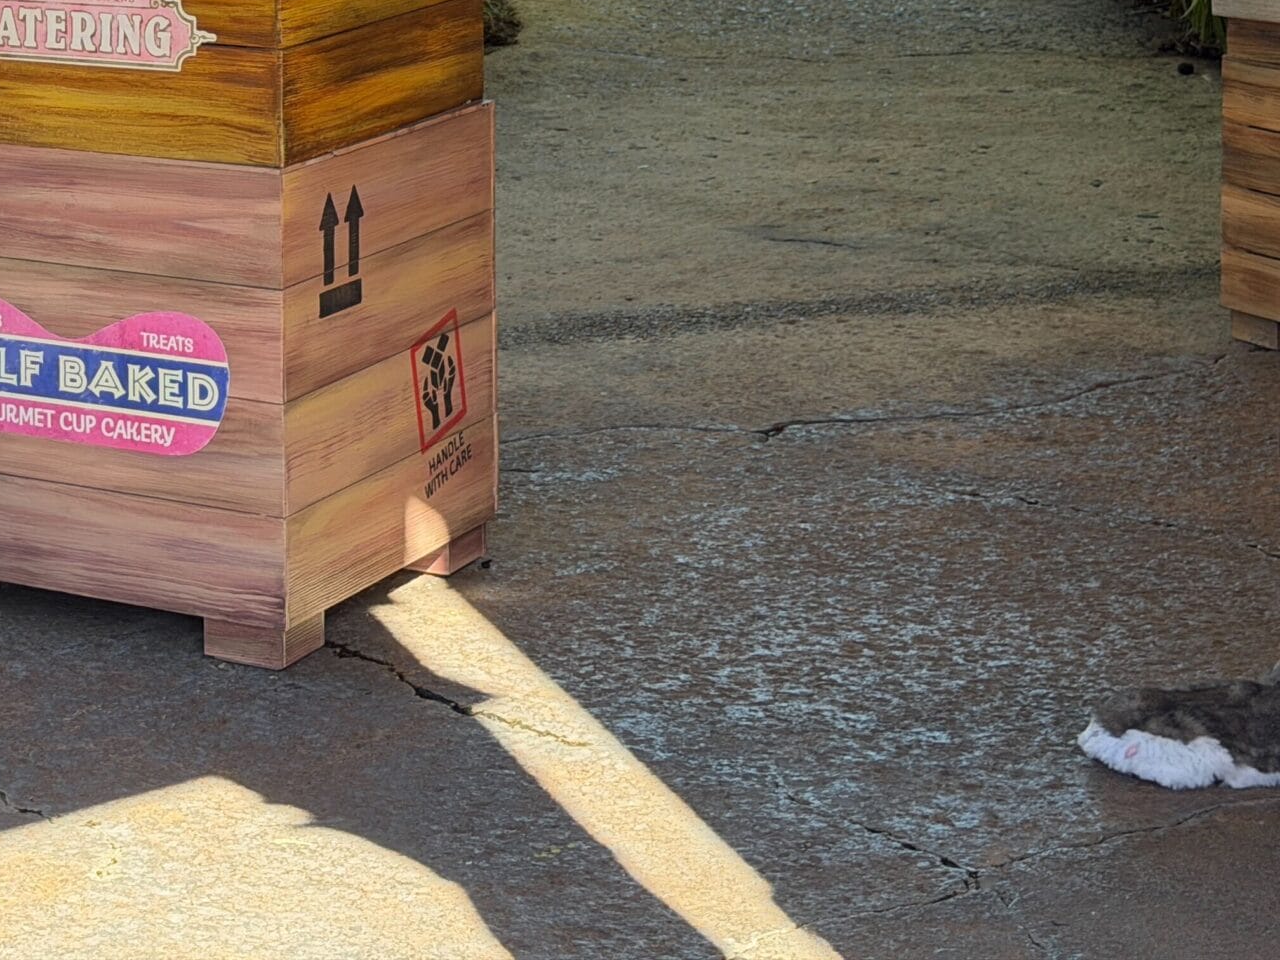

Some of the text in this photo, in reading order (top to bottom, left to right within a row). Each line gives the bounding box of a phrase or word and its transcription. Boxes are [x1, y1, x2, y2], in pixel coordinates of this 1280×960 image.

[140, 331, 194, 353] TREATS
[58, 354, 220, 412] BAKED
[59, 412, 97, 434] CUP
[101, 417, 176, 447] CAKERY
[424, 443, 473, 499] WITH CARE
[429, 431, 465, 476] HANDLE
